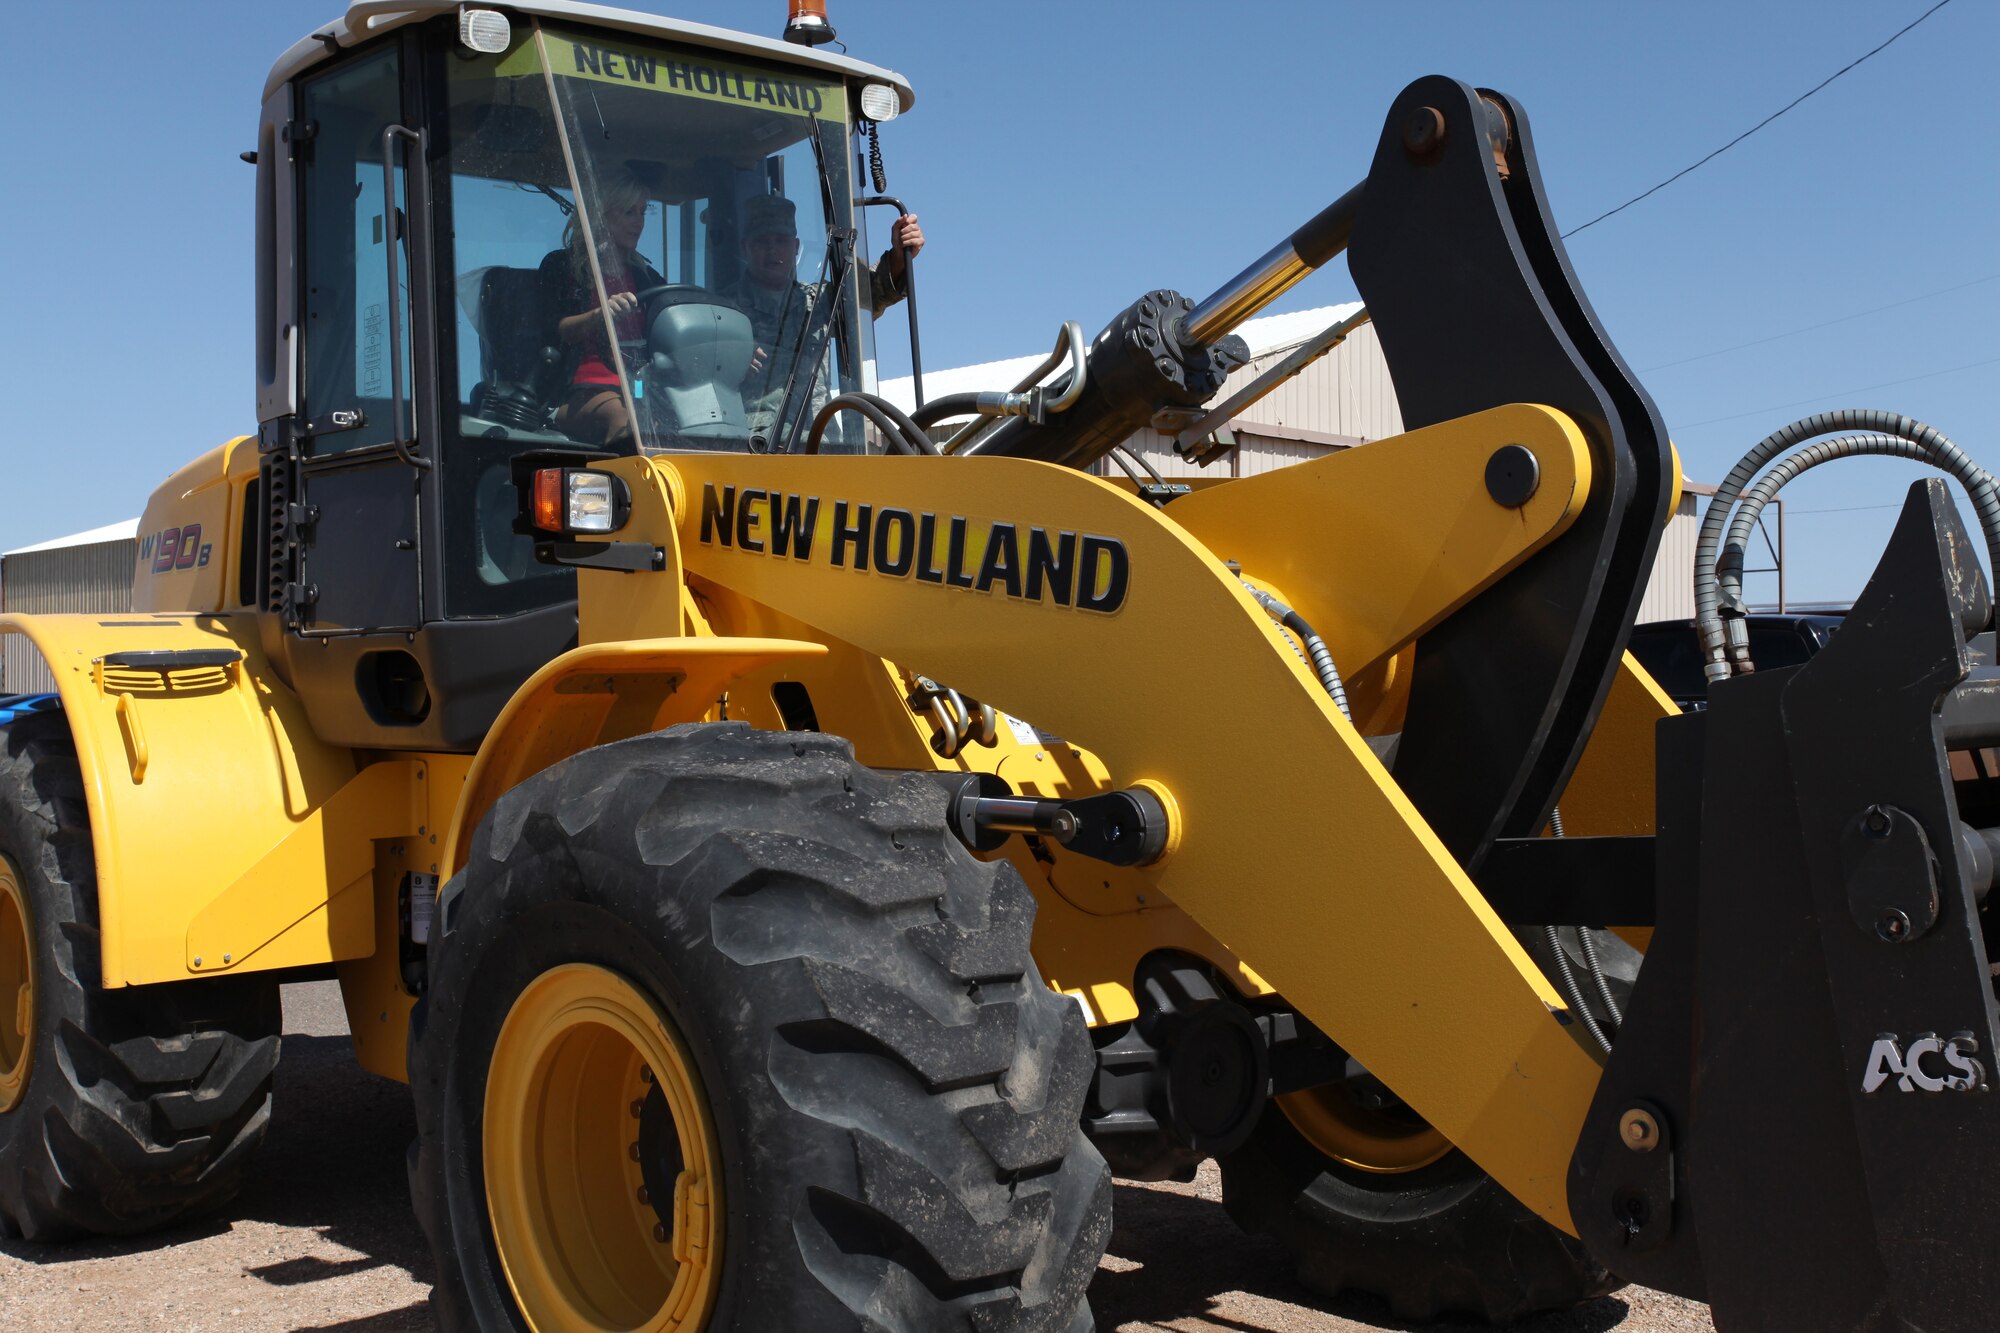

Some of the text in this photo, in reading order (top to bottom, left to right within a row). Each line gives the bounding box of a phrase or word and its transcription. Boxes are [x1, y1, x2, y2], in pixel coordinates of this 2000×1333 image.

[573, 42, 822, 113] NEW HOLLAND
[700, 482, 1130, 613] NEW HOLLAND
[1861, 1034, 1984, 1093] ACS
